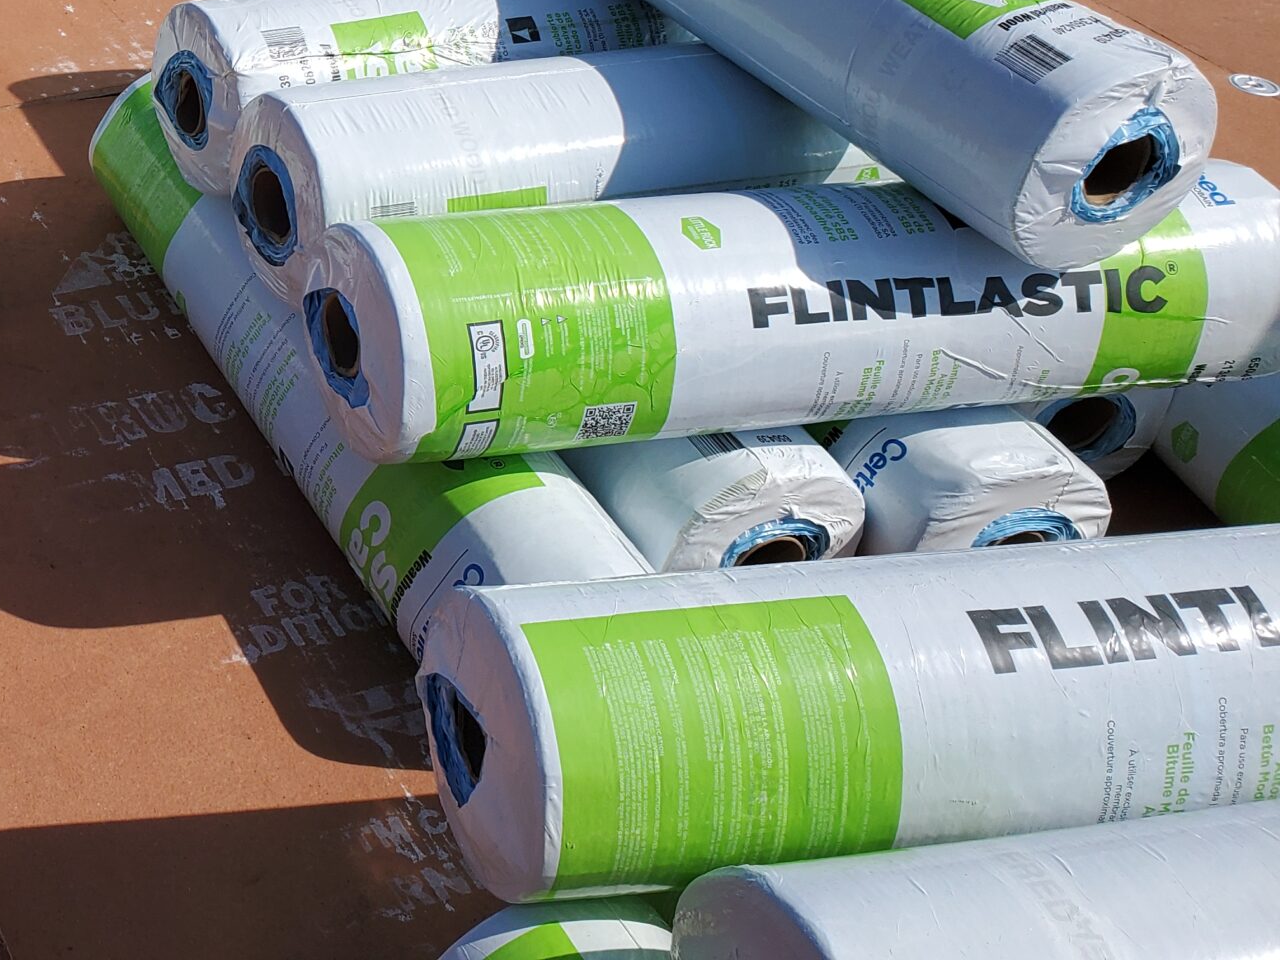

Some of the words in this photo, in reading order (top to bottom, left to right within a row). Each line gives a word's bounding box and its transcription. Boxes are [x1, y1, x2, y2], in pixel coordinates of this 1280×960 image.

[998, 11, 1030, 32] Wood
[898, 215, 916, 236] SBS
[903, 195, 937, 232] Cubierta
[912, 221, 925, 234] de
[831, 220, 850, 242] SBS
[847, 228, 859, 241] en
[747, 265, 1170, 329] FLINTLASTIC
[242, 312, 264, 346] Bitume
[873, 359, 885, 390] Feuille
[931, 349, 942, 377] Betún
[856, 367, 873, 398] Bitume
[965, 585, 1280, 674] FLINTL
[1218, 696, 1228, 748] Cobertura
[1106, 720, 1116, 774] Couverture
[1239, 727, 1249, 750] Para
[1261, 724, 1275, 768] Betún
[1162, 744, 1180, 798] Bitume
[1180, 731, 1196, 784] Feuille
[1237, 752, 1245, 770] uso
[1126, 760, 1136, 791] utiliser
[1211, 749, 1226, 802] aproximada
[1176, 787, 1190, 806] de
